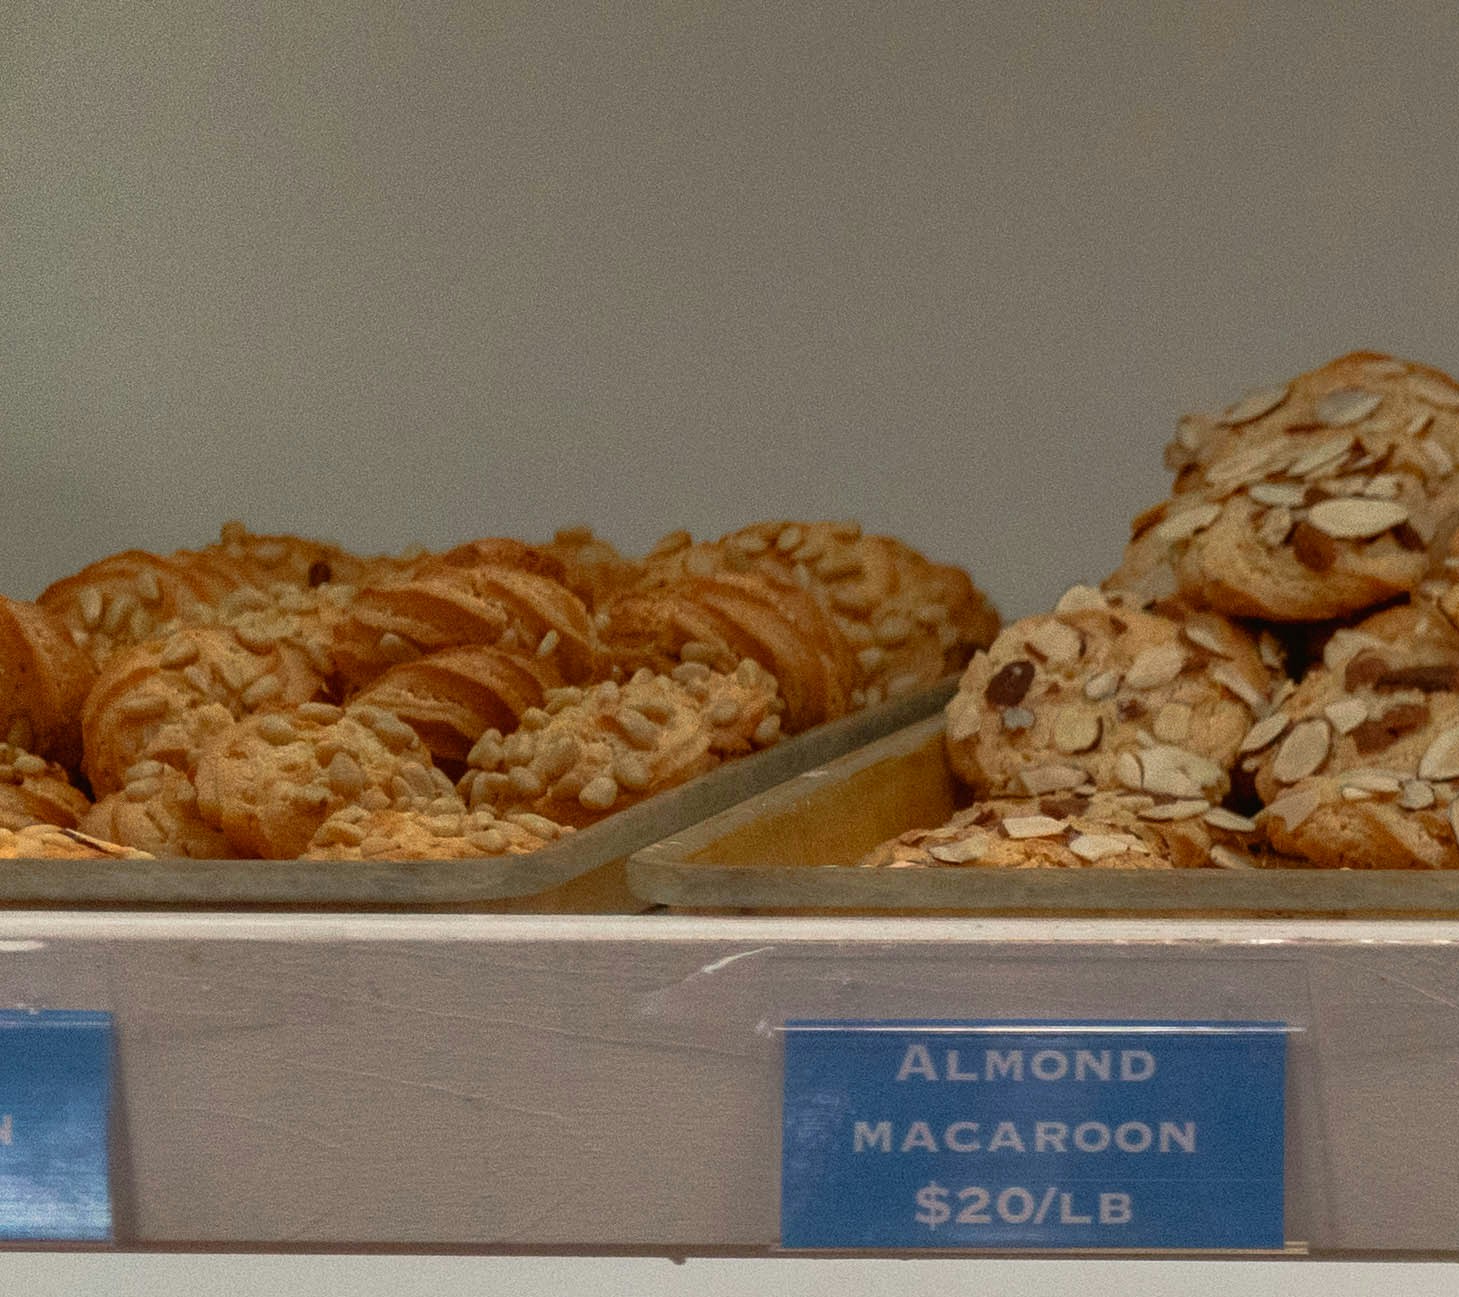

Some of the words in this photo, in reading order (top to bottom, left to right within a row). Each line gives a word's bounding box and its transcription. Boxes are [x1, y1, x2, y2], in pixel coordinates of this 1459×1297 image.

[899, 1045, 1155, 1081] ALMOND
[854, 1120, 1196, 1153] MACAROON
[915, 1182, 1132, 1229] $20/LB
